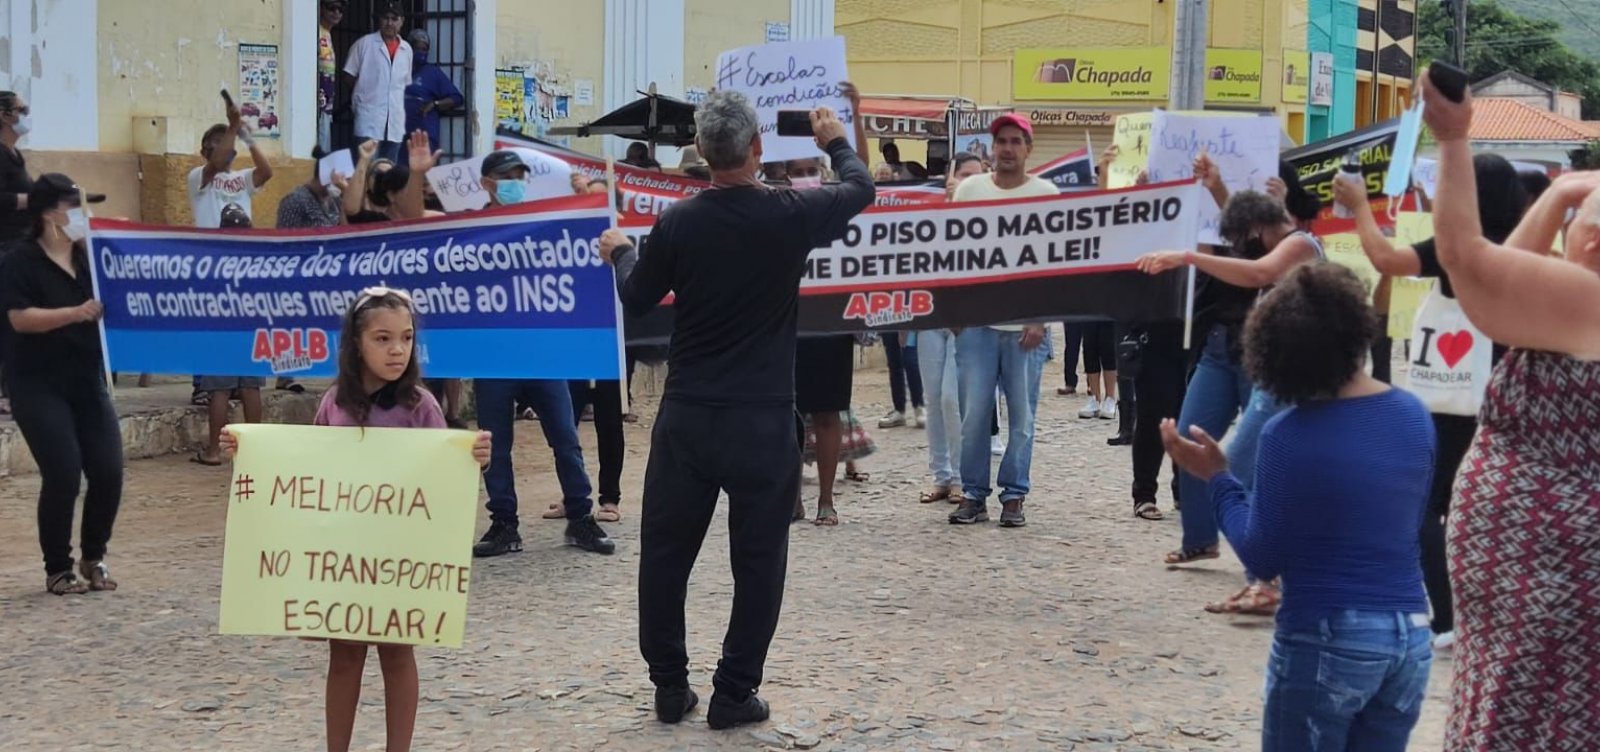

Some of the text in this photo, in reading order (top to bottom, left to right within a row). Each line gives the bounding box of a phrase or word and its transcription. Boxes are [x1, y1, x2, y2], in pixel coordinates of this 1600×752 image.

[1076, 66, 1153, 87] Chapada
[1226, 71, 1260, 83] Chapada
[959, 110, 981, 130] MEGA
[1031, 110, 1111, 123] Óticas Chapada
[1322, 145, 1391, 171] SARIAL
[623, 173, 682, 192] fechadas
[683, 185, 701, 195] po
[870, 220, 937, 246] PISO
[945, 217, 988, 241] DO
[997, 197, 1182, 238] MAGISTÉRIO
[102, 247, 191, 280] Queremos
[196, 256, 212, 279] o
[213, 252, 301, 288] repasse
[301, 246, 346, 278] dos
[349, 242, 428, 276] valores
[434, 229, 604, 273] descontados
[841, 247, 1008, 278] DETERMINA
[1017, 245, 1039, 267] A
[1048, 236, 1101, 263] LEI!
[127, 274, 575, 325] em contracheques menente ao INSS
[842, 290, 934, 318] APLB
[866, 309, 913, 326] Sindicato
[252, 329, 330, 362] APLB
[1413, 327, 1436, 367] I
[271, 351, 312, 374] Sindicato
[235, 474, 431, 520] # MELHORIA
[259, 550, 469, 594] NO TRANSPORTE
